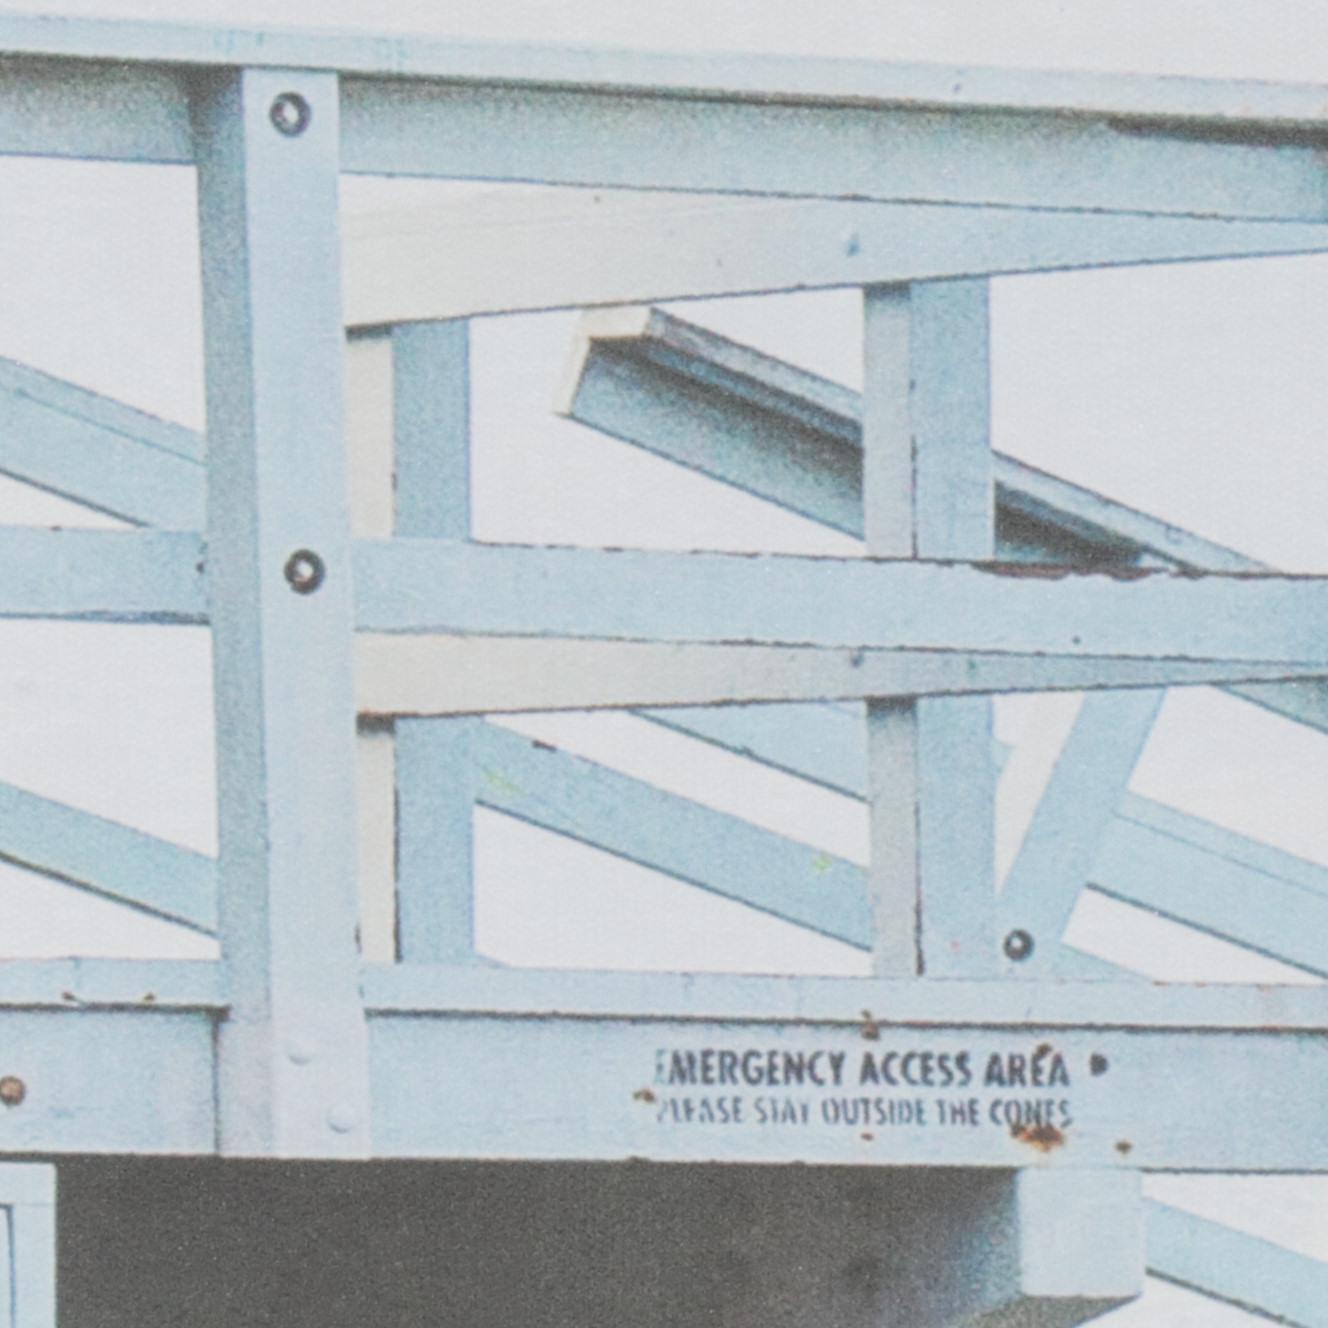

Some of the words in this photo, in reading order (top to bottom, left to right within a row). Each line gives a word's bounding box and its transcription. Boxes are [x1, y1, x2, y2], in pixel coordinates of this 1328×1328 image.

[655, 1047, 847, 1087] EMERGENCY
[859, 1051, 974, 1087] ACCESS
[983, 1051, 1072, 1088] AREA
[821, 1096, 927, 1126] OUTSIDE
[936, 1098, 982, 1127] THE
[989, 1098, 1074, 1128] CONES
